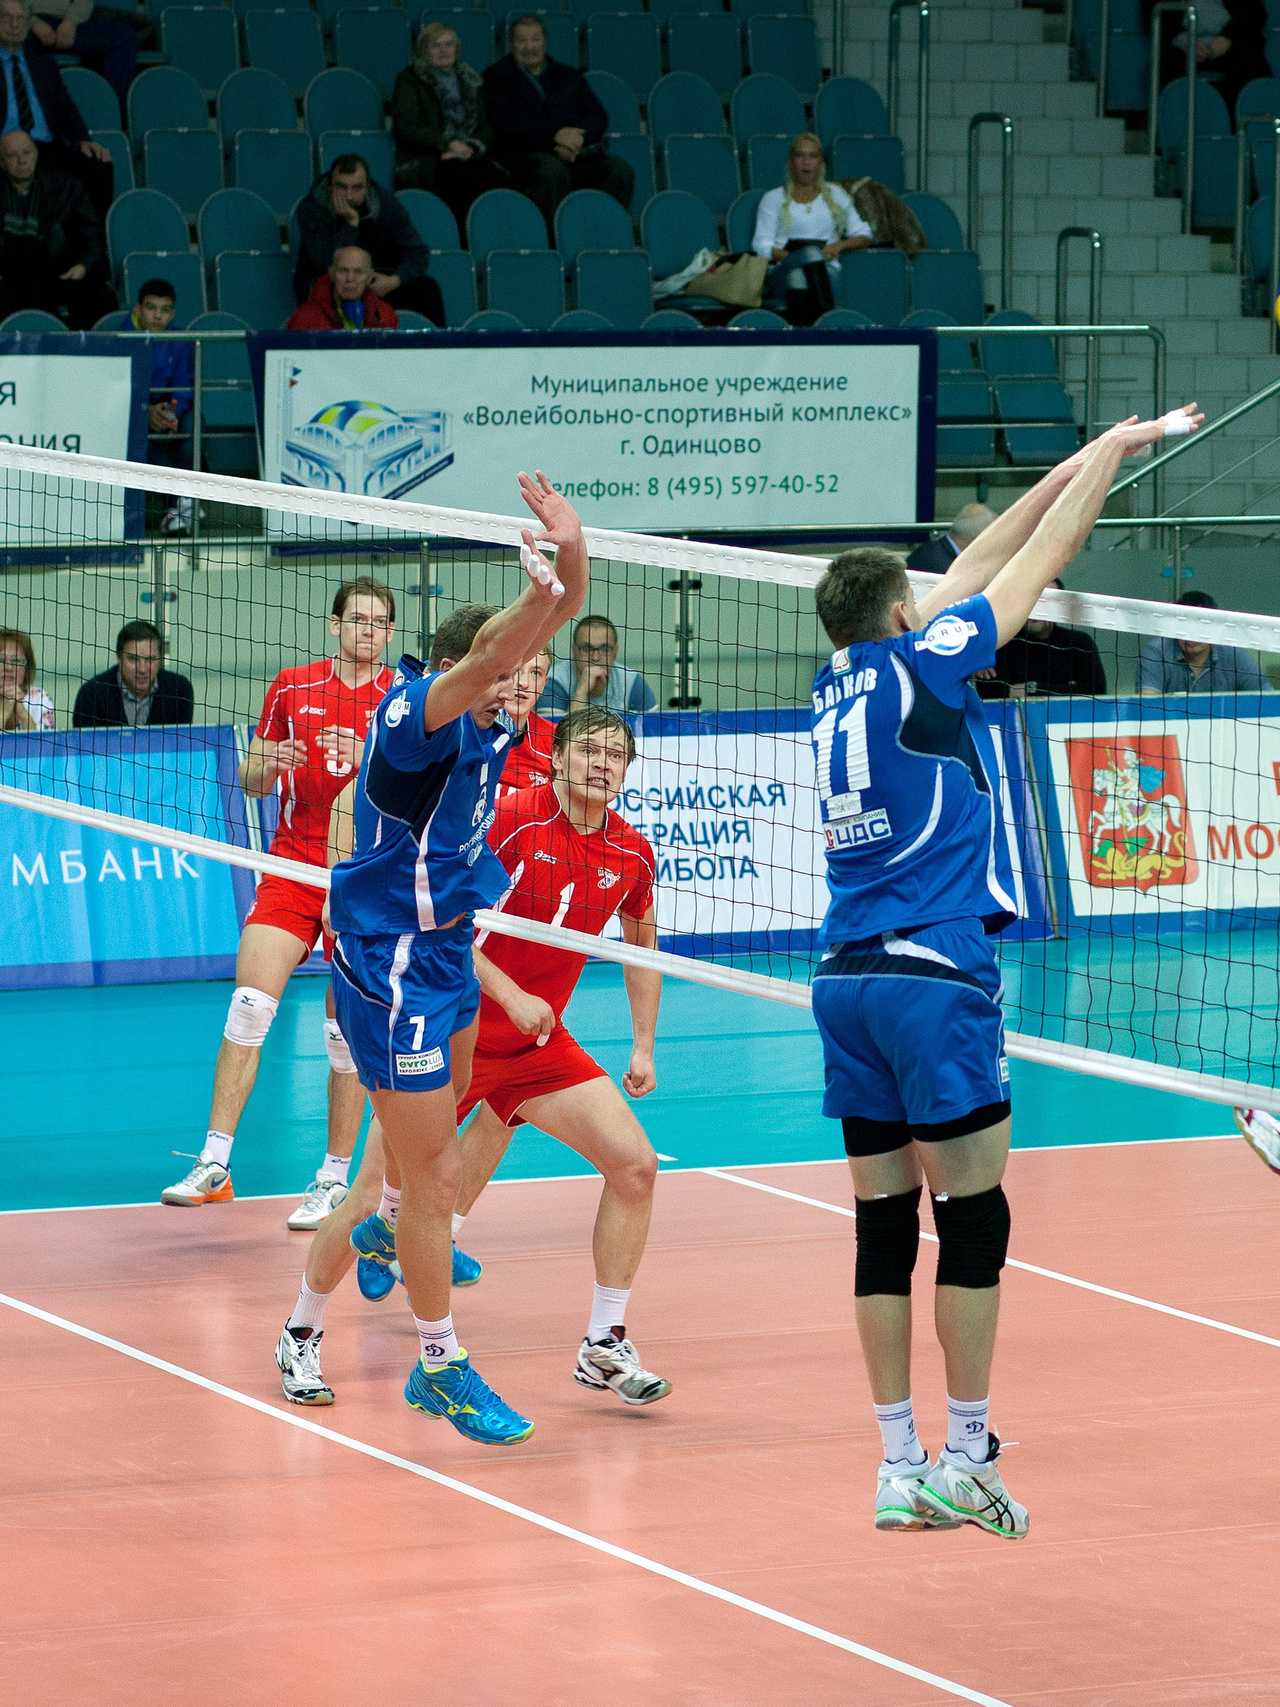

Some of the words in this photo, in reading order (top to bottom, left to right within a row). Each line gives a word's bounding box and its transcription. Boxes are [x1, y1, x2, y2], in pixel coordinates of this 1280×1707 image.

[531, 375, 708, 398] Муниципальное
[716, 375, 848, 396] учреждение
[463, 402, 784, 428] «Волейбольно-спортивный
[792, 404, 912, 422] комплекс»
[621, 439, 635, 455] г.
[643, 434, 762, 457] Одинцово
[551, 478, 641, 500] елефон:
[648, 477, 659, 496] 8
[668, 475, 722, 500] (495)
[731, 474, 839, 495] 597-40-52
[812, 694, 871, 802] 11
[12, 846, 200, 887] МБАНК
[409, 1014, 426, 1051] 7
